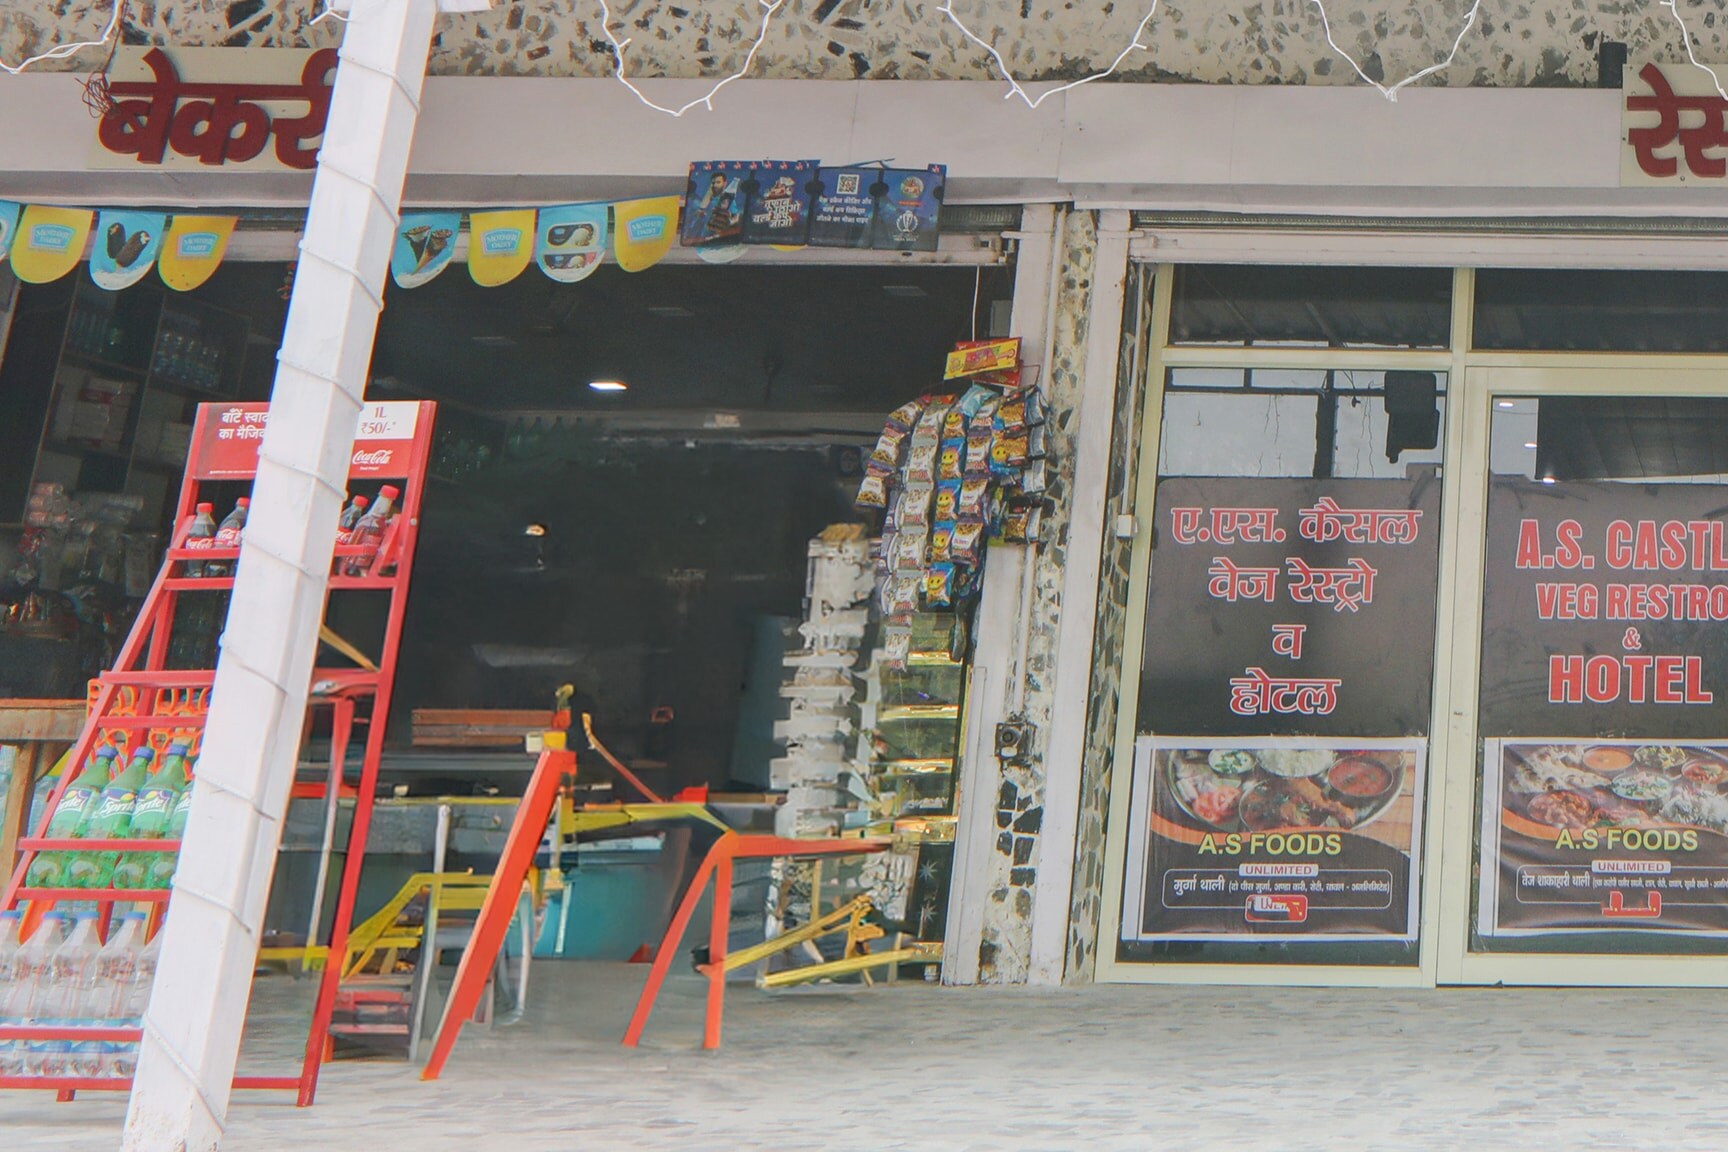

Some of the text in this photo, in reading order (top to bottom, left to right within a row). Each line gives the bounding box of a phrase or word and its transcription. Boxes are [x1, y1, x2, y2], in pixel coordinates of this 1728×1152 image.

[219, 428, 235, 440] का
[1170, 497, 1424, 545] ए.एस. कैसल
[1515, 519, 1596, 570] A.S.
[1208, 556, 1378, 613] वेज रेस्ट्रो
[1535, 583, 1599, 620] VEG
[1271, 623, 1307, 660] व
[1621, 626, 1642, 650] &
[1229, 667, 1342, 716] होटल
[1547, 654, 1714, 704] HOTEL
[1198, 832, 1343, 857] A.S FOODS
[1555, 828, 1699, 852] A.S FOODS
[1244, 864, 1313, 877] UNLIMITED
[1521, 870, 1536, 887] वेज
[1571, 871, 1591, 888] थाली
[1597, 861, 1665, 872] UNLIMITED
[1173, 873, 1198, 896] मुर्गा
[1199, 874, 1226, 892] थाली
